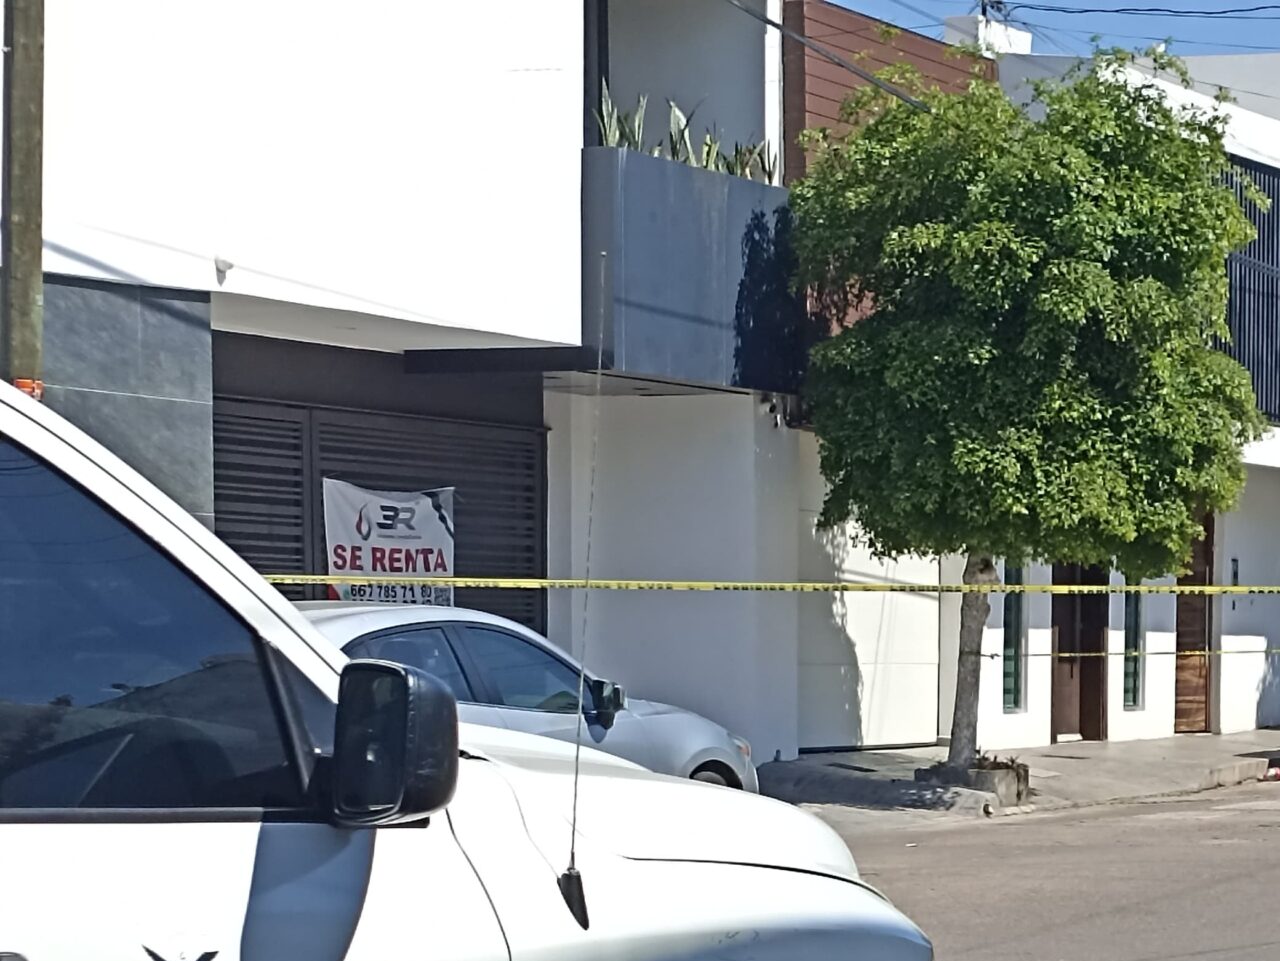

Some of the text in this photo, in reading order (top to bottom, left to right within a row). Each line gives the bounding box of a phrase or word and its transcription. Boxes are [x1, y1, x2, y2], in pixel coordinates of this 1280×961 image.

[333, 544, 448, 573] SE RENTA
[350, 584, 374, 598] 667
[377, 584, 397, 599] 785
[401, 585, 415, 599] 71
